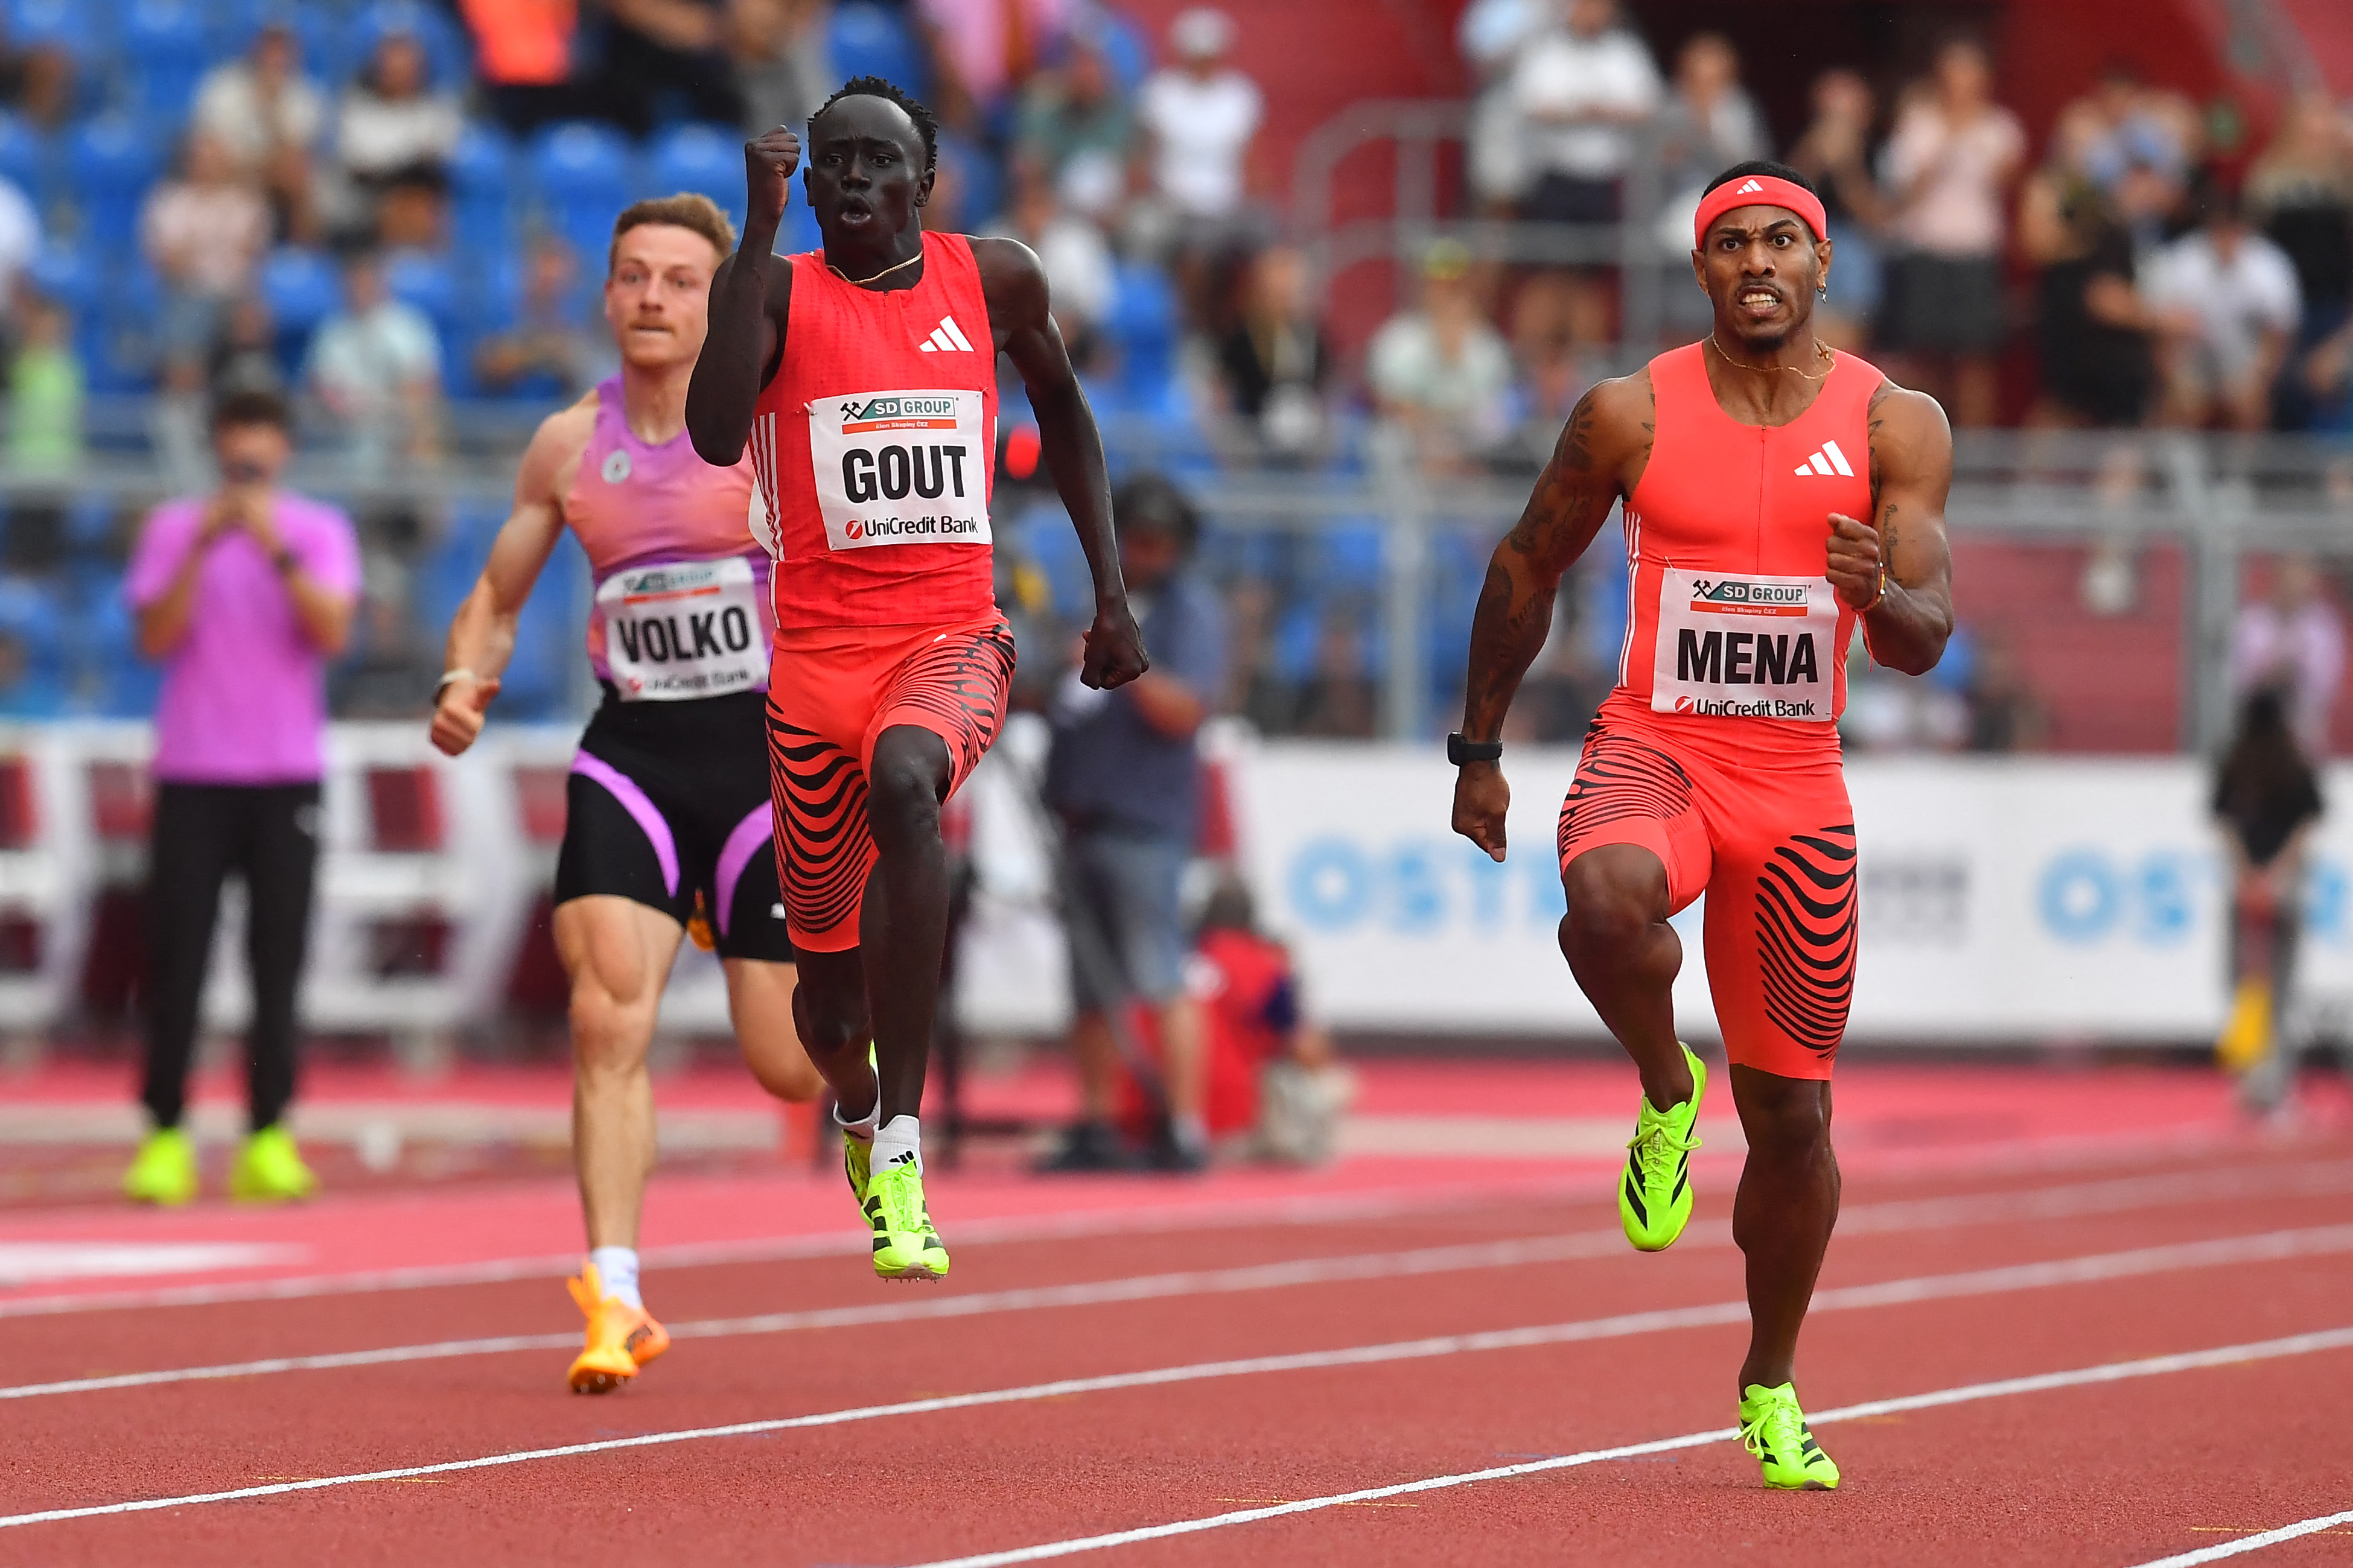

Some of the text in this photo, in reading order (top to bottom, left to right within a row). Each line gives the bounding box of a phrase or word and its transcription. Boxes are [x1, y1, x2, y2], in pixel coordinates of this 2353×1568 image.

[875, 401, 951, 415] SD GROUP
[842, 445, 967, 503] GOUT
[864, 516, 979, 536] UniCredit Bank
[1723, 585, 1803, 601] SD GROUP
[617, 606, 750, 662] VOLKO
[1677, 628, 1818, 685] MENA
[1696, 699, 1815, 717] UniCredit Bank
